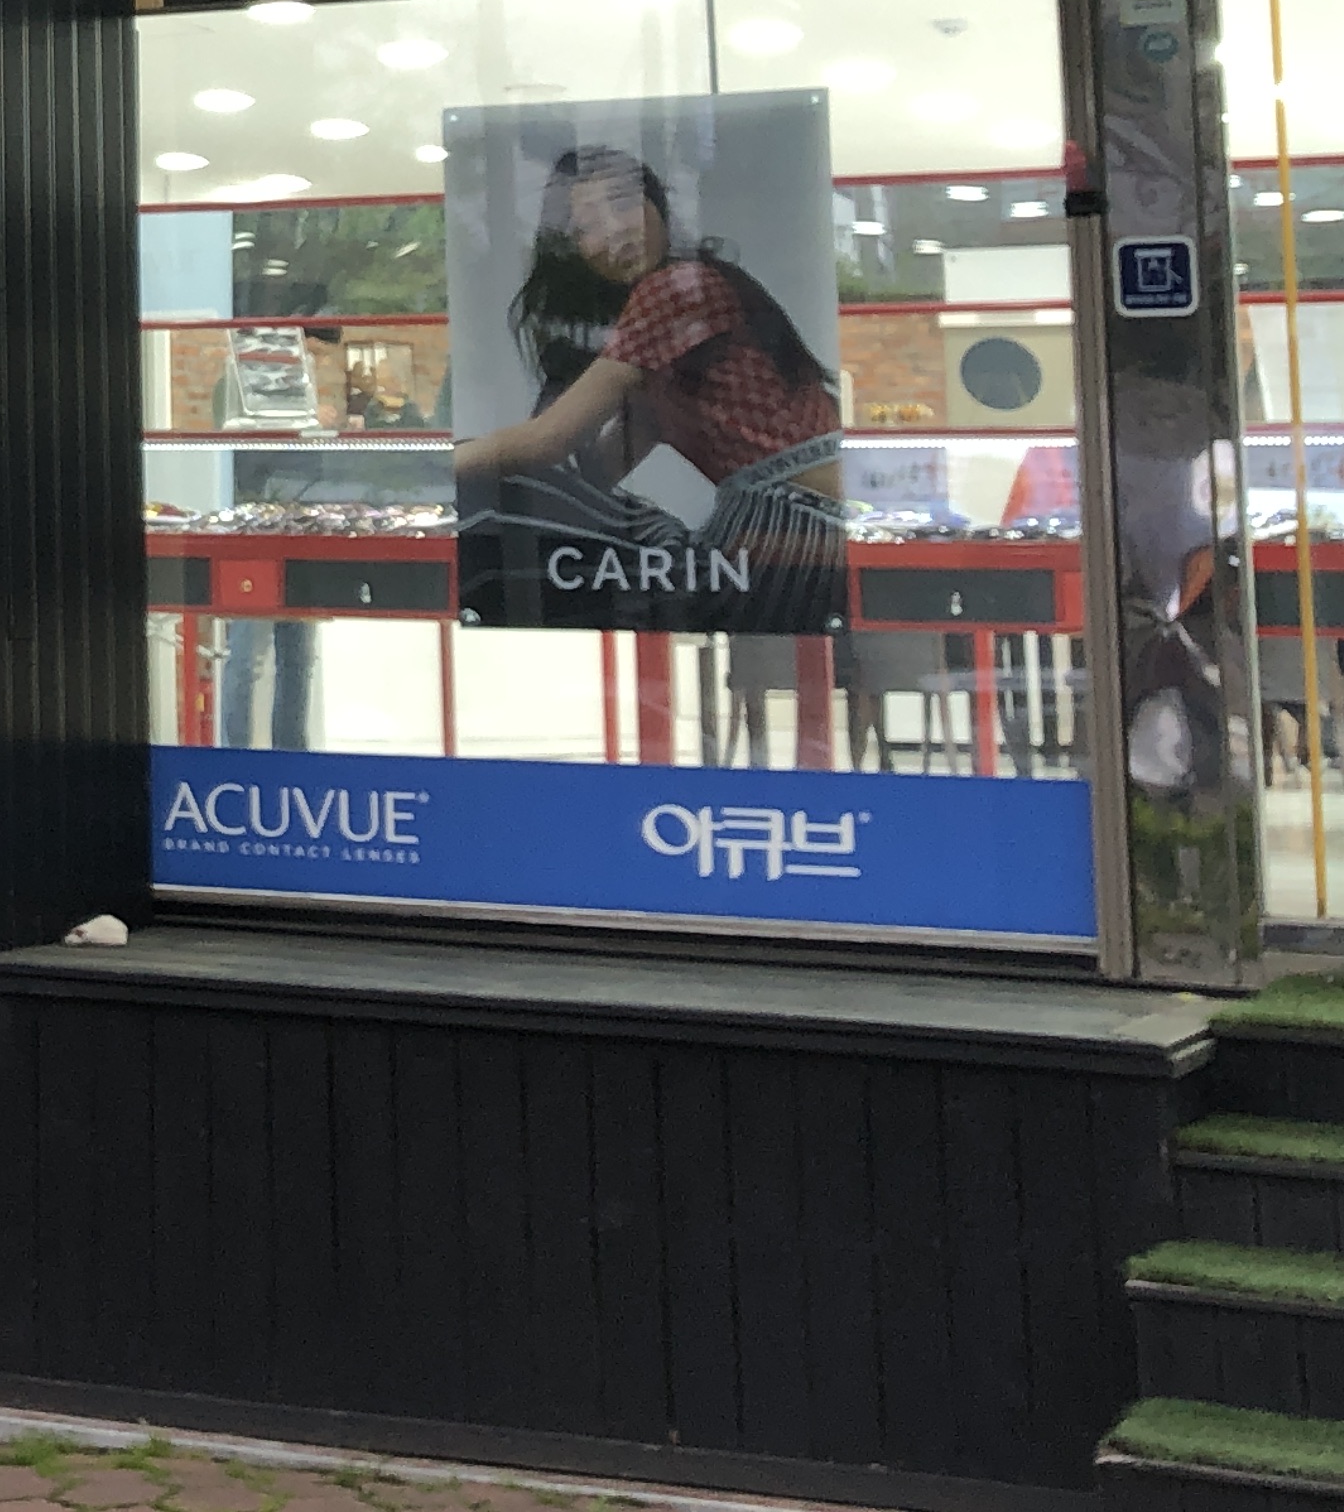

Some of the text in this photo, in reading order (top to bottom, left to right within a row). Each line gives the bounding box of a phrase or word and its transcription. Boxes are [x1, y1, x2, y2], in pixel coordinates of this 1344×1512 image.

[547, 547, 751, 593] CARIN
[164, 781, 420, 844] ACUVUE
[642, 803, 861, 881] 아큐브
